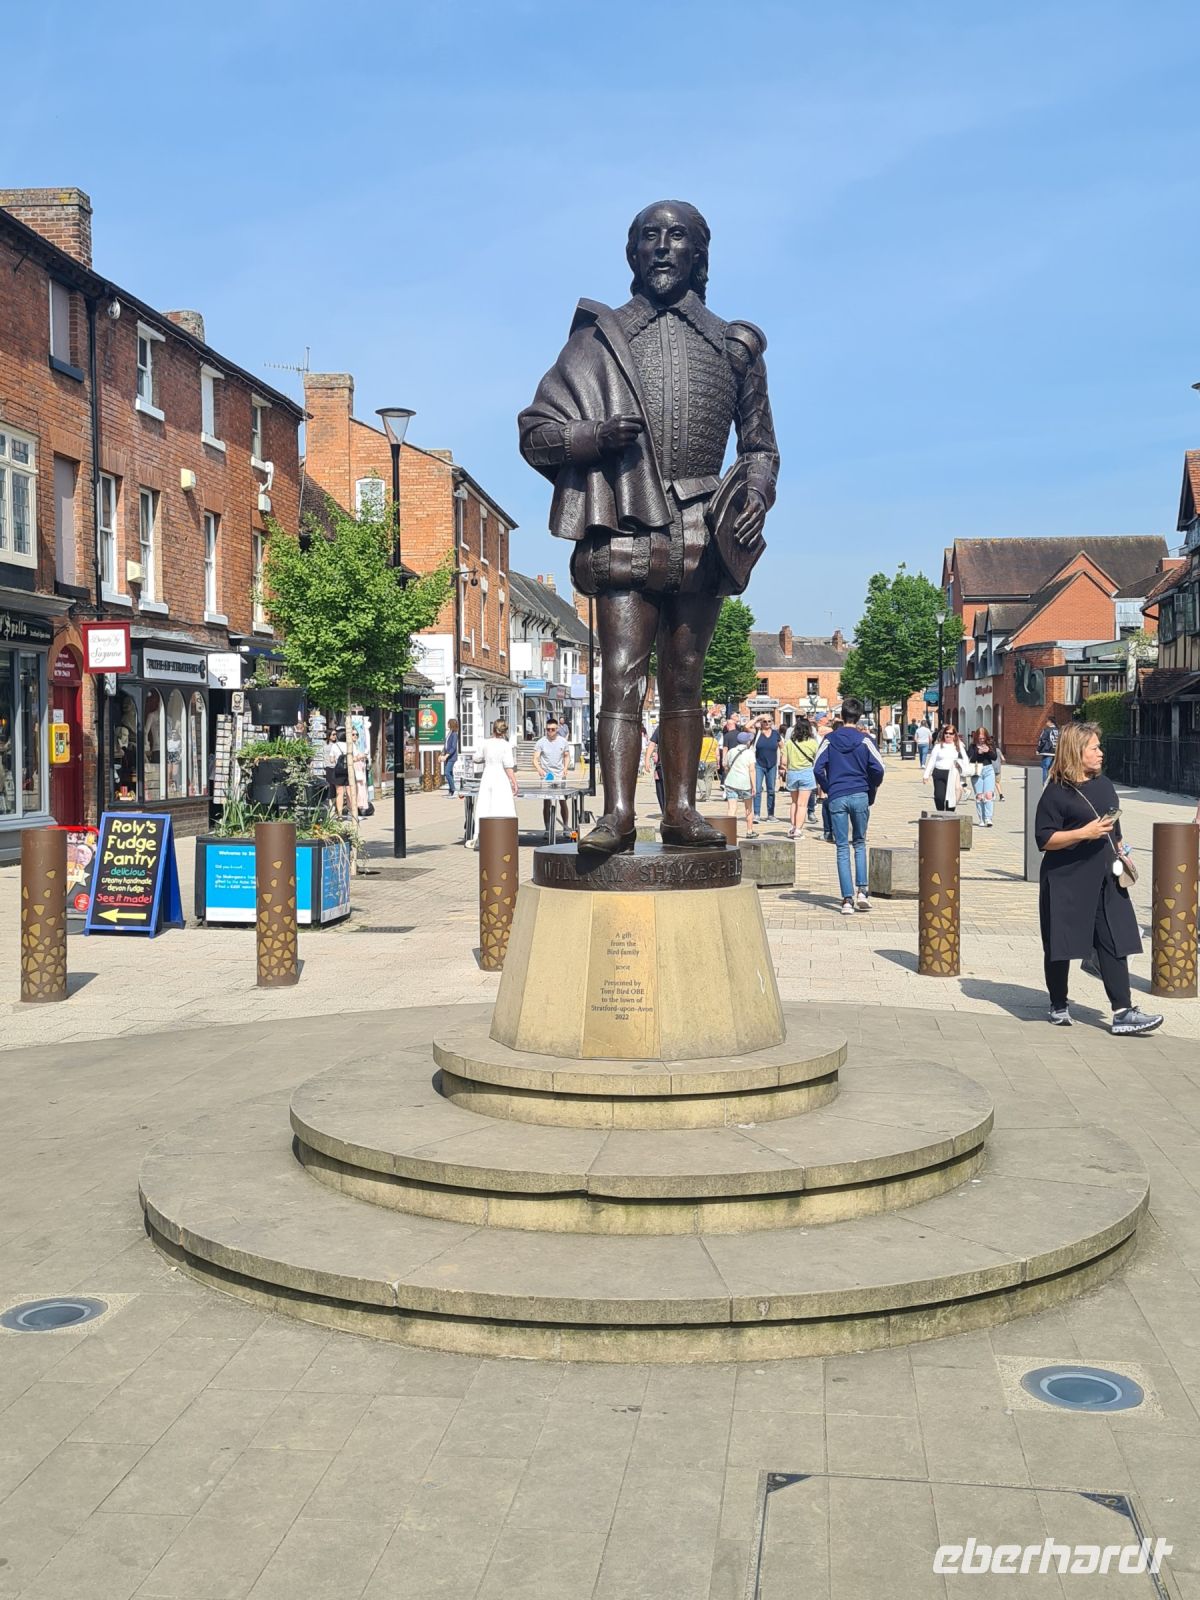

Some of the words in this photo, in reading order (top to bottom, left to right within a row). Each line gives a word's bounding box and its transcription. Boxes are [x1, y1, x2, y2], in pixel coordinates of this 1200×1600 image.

[91, 647, 122, 663] Suzanne
[112, 819, 157, 836] Roly's
[107, 835, 157, 853] Fudge
[103, 850, 157, 869] Pantry
[110, 867, 146, 876] delicious
[101, 877, 122, 885] creamy
[123, 877, 152, 885] handmade
[107, 884, 126, 892] devon
[127, 884, 145, 893] fudge
[96, 893, 115, 902] See
[116, 894, 123, 902] it
[123, 894, 153, 903] made!
[622, 932, 632, 940] gift
[620, 949, 639, 957] family
[634, 980, 641, 988] by
[591, 1005, 653, 1013] Stratford-upon-Avon
